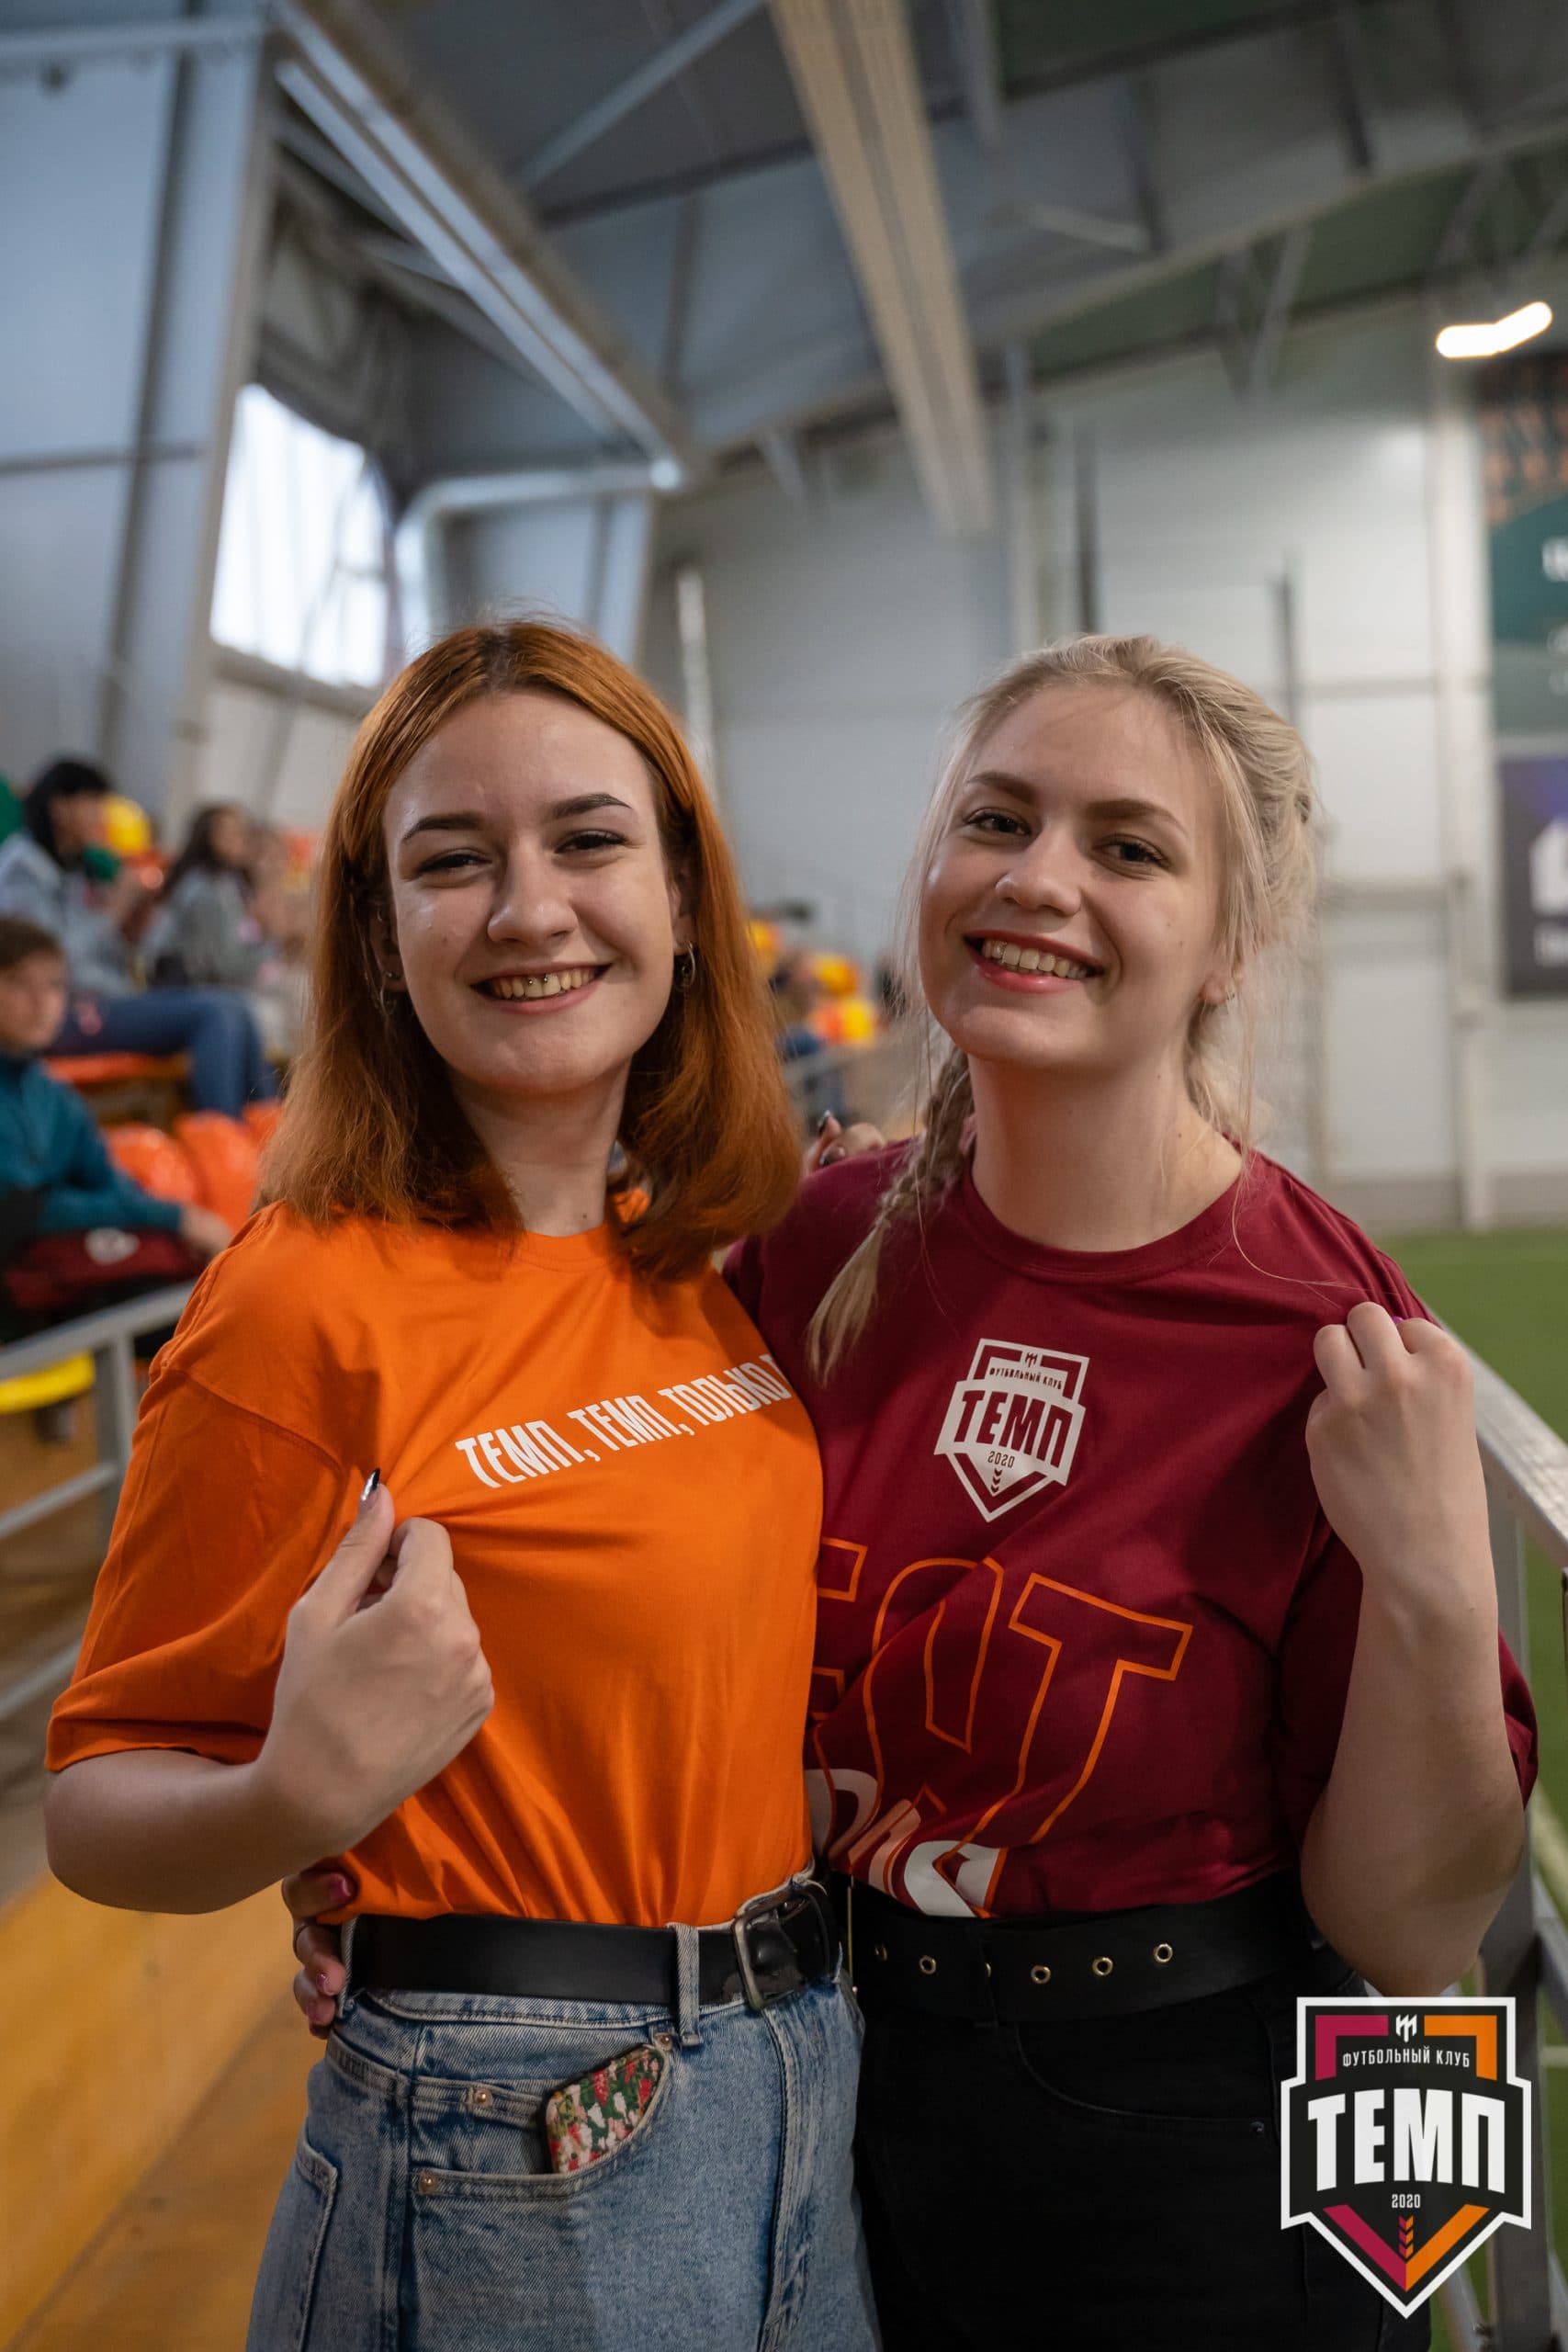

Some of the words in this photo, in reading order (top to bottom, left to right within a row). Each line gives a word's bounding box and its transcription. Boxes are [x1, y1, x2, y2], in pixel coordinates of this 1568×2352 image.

[988, 1367, 1042, 1383] ФУТБОЛЬНЫЙ
[1043, 1376, 1063, 1390] КЛУБ
[455, 1419, 601, 1488] ТЕМП,
[566, 1395, 695, 1452] ТЕМП,
[657, 1362, 792, 1426] ТОЛЬКО
[953, 1389, 1073, 1468] ТЕМП
[987, 1451, 1015, 1468] 2020
